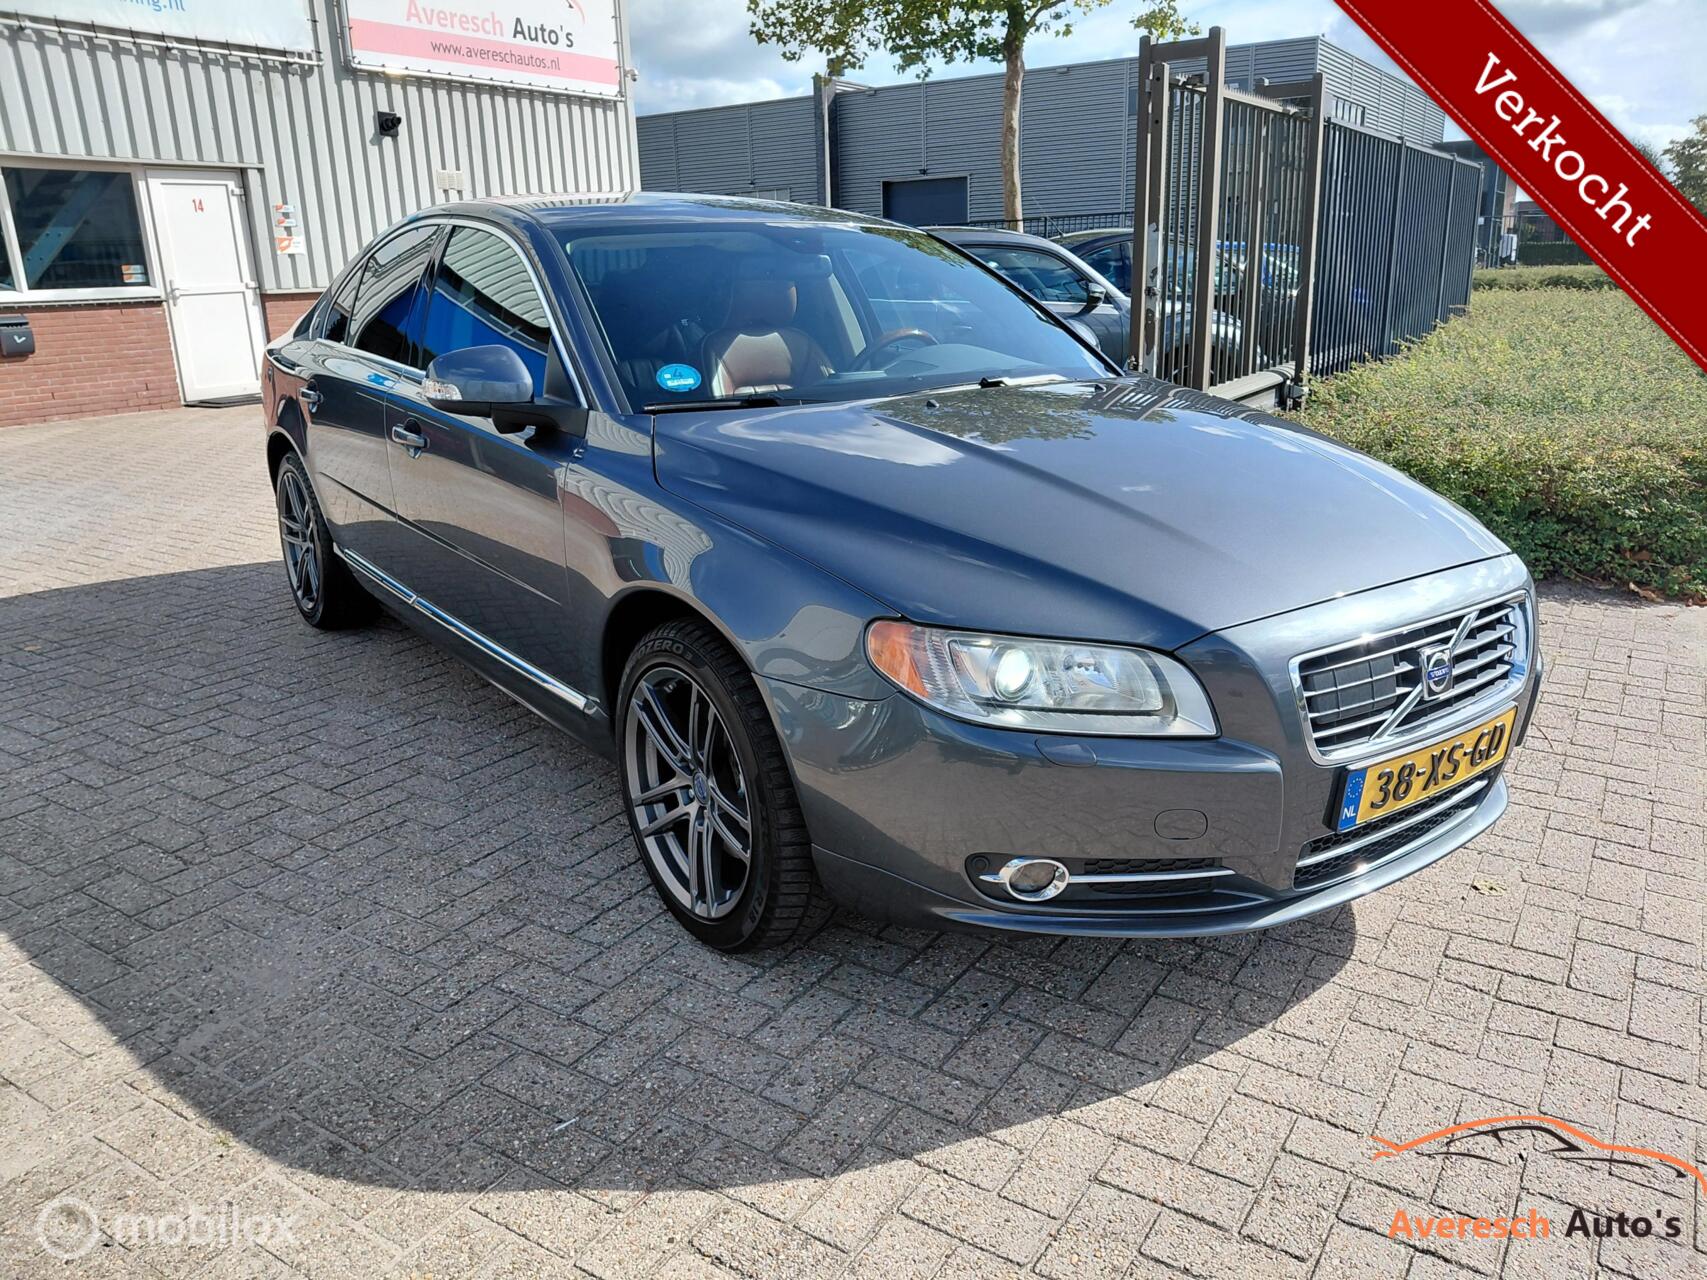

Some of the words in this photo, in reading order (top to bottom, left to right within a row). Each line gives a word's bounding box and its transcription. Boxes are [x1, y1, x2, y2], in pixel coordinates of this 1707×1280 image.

[405, 0, 504, 37] Averesch
[512, 17, 575, 48] Auto's
[430, 41, 561, 71] www.avereschautos.nl
[192, 198, 204, 212] 14
[1370, 722, 1506, 809] 38-XS-GD
[1343, 805, 1356, 819] NL
